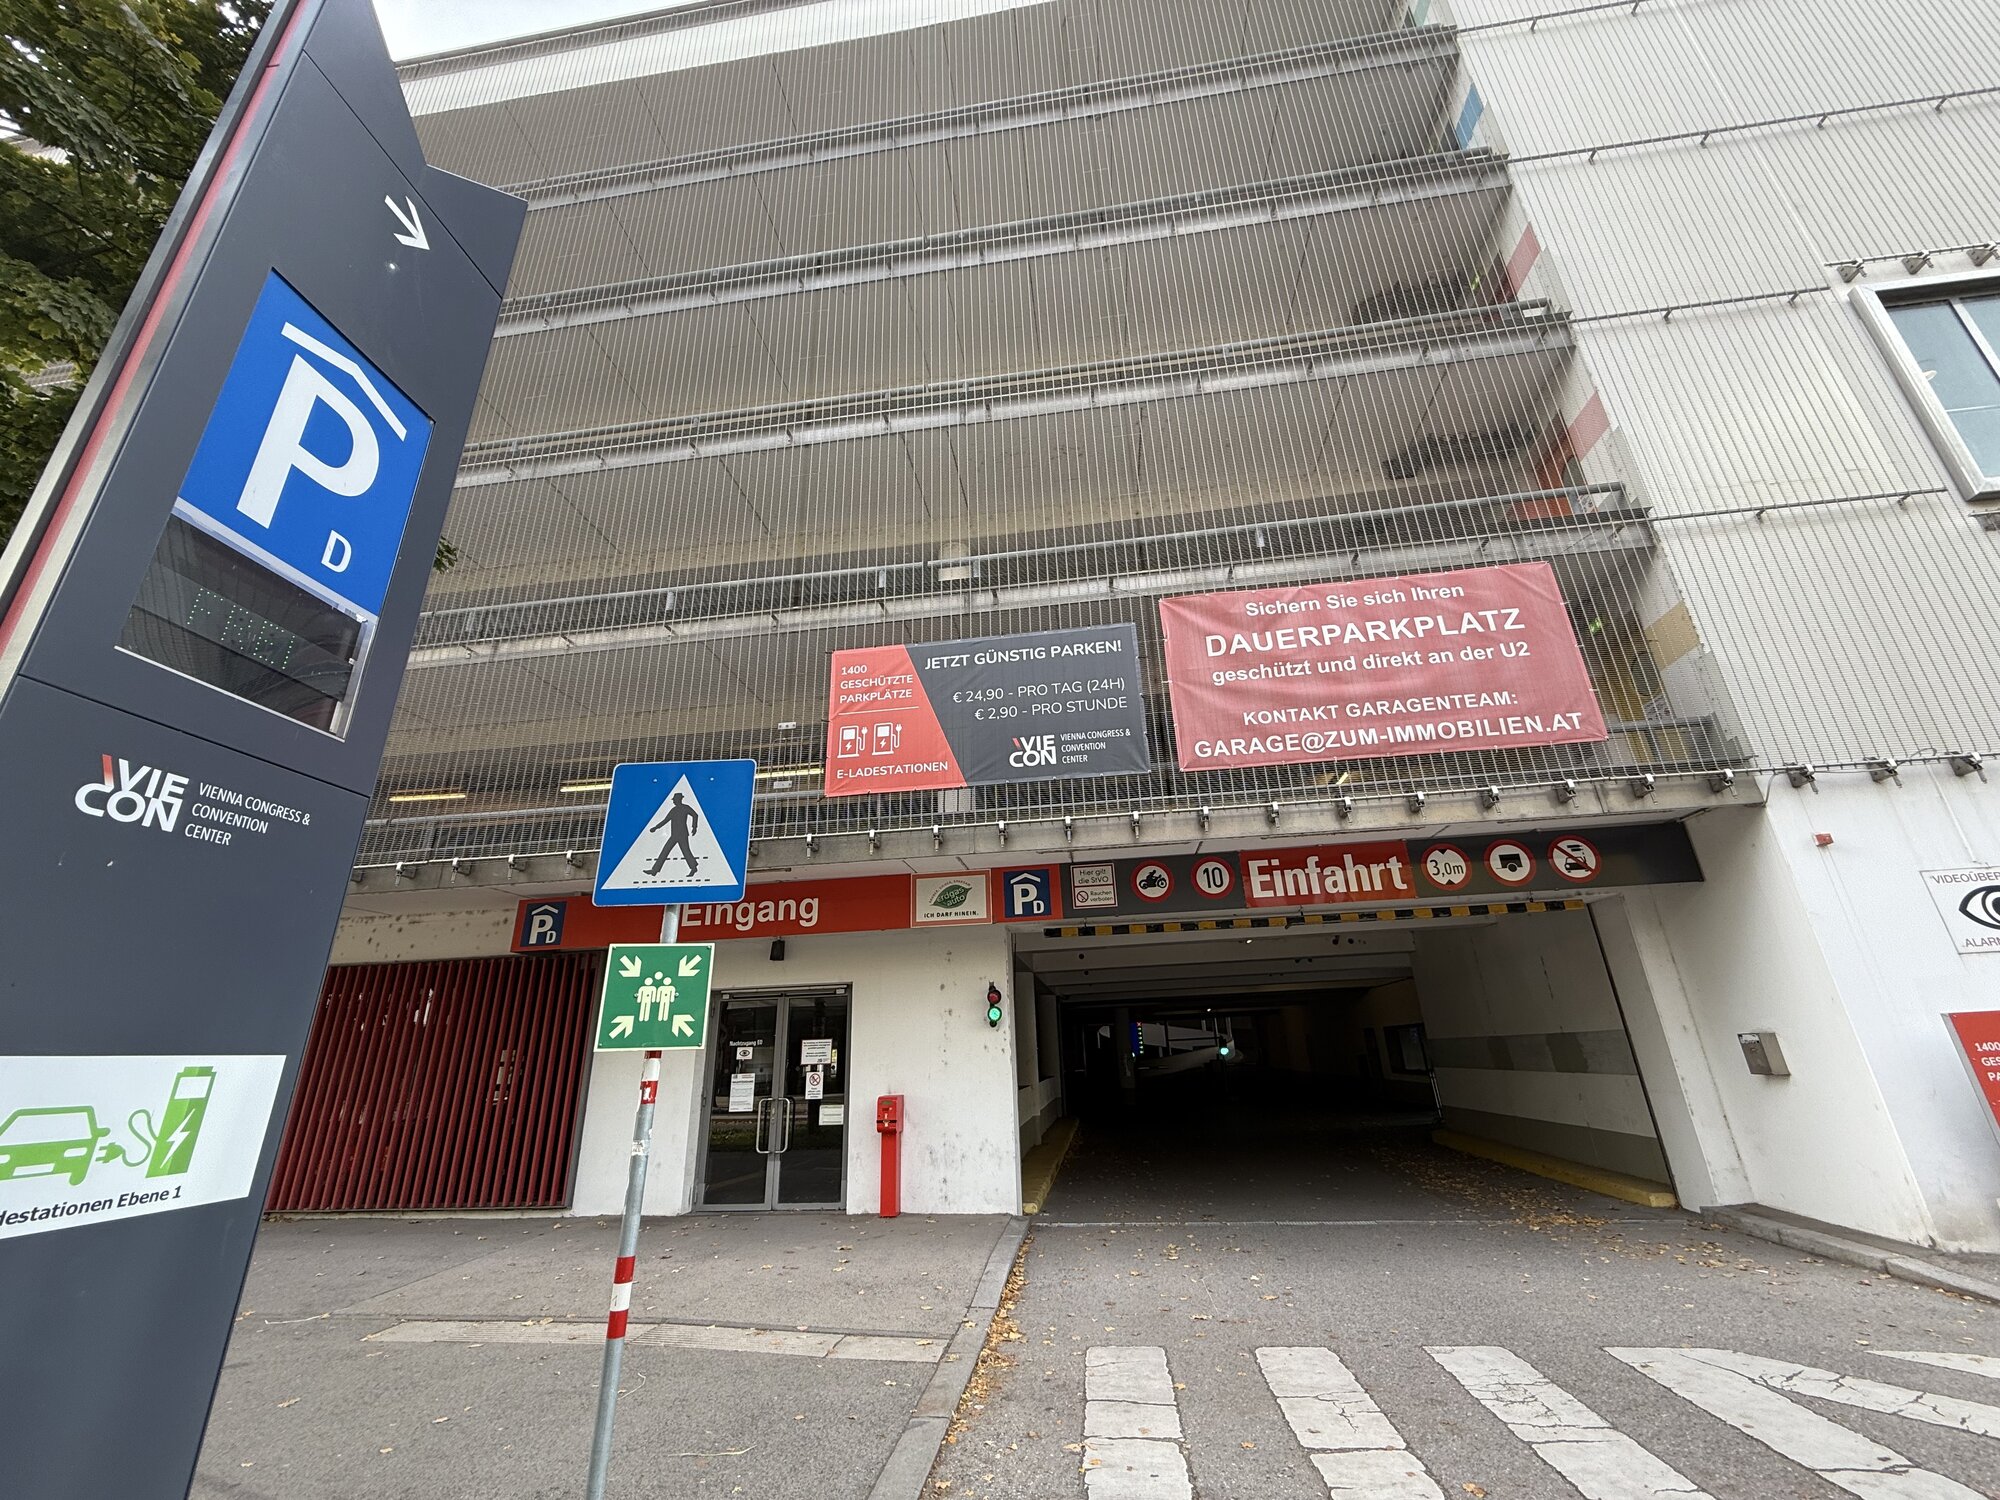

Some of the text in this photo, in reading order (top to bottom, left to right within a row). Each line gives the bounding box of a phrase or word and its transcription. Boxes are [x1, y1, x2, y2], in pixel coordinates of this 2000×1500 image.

[236, 353, 380, 529] P
[321, 529, 352, 573] D
[1245, 583, 1465, 617] Sichern Sie sich Ihren
[186, 587, 297, 669] FREI
[1205, 607, 1525, 658] DAUERPARKPLATZ
[925, 639, 1122, 670] JETZT GÜNSTIG PARKEN!
[1212, 641, 1531, 686] geschützt und direkt an der U2
[840, 674, 914, 689] GESCHÜTZTE
[841, 664, 867, 675] 1400
[839, 688, 913, 704] PARKPLÄTZE
[953, 691, 962, 704] €
[965, 688, 1004, 703] 24,90
[1018, 684, 1048, 698] PRO
[1052, 681, 1082, 695] TAG
[1087, 677, 1125, 694] (24H)
[974, 708, 984, 721] €
[988, 705, 1018, 720] 2,90
[1031, 701, 1062, 716] PRO
[1066, 696, 1128, 713] STUNDE
[1243, 690, 1518, 726] KONTAKT GARAGENTEAM:
[1060, 728, 1131, 742] VIENNA CONGRESS &
[1061, 741, 1106, 753] CONVENTION
[1194, 712, 1582, 759] GARAGE@ZUM-IMMOBILIEN.AT
[837, 761, 948, 779] E-LADESTATIONEN
[1009, 745, 1057, 768] CON
[1062, 754, 1088, 764] CENTER
[74, 783, 184, 833] CON
[199, 781, 311, 826] VIENNA CONGRESS &
[191, 802, 269, 834] CONVENTION
[184, 823, 232, 846] CENTER
[1203, 866, 1224, 889] 10
[1247, 853, 1408, 899] Einfahrt
[1431, 858, 1465, 877] 3,0m
[937, 886, 965, 903] erdgas
[1013, 884, 1045, 915] P D
[680, 896, 820, 931] Eingang
[529, 915, 557, 945] P D
[1974, 1041, 2000, 1052] 1400
[117, 1190, 170, 1208] Ebene
[172, 1185, 182, 1199] 1
